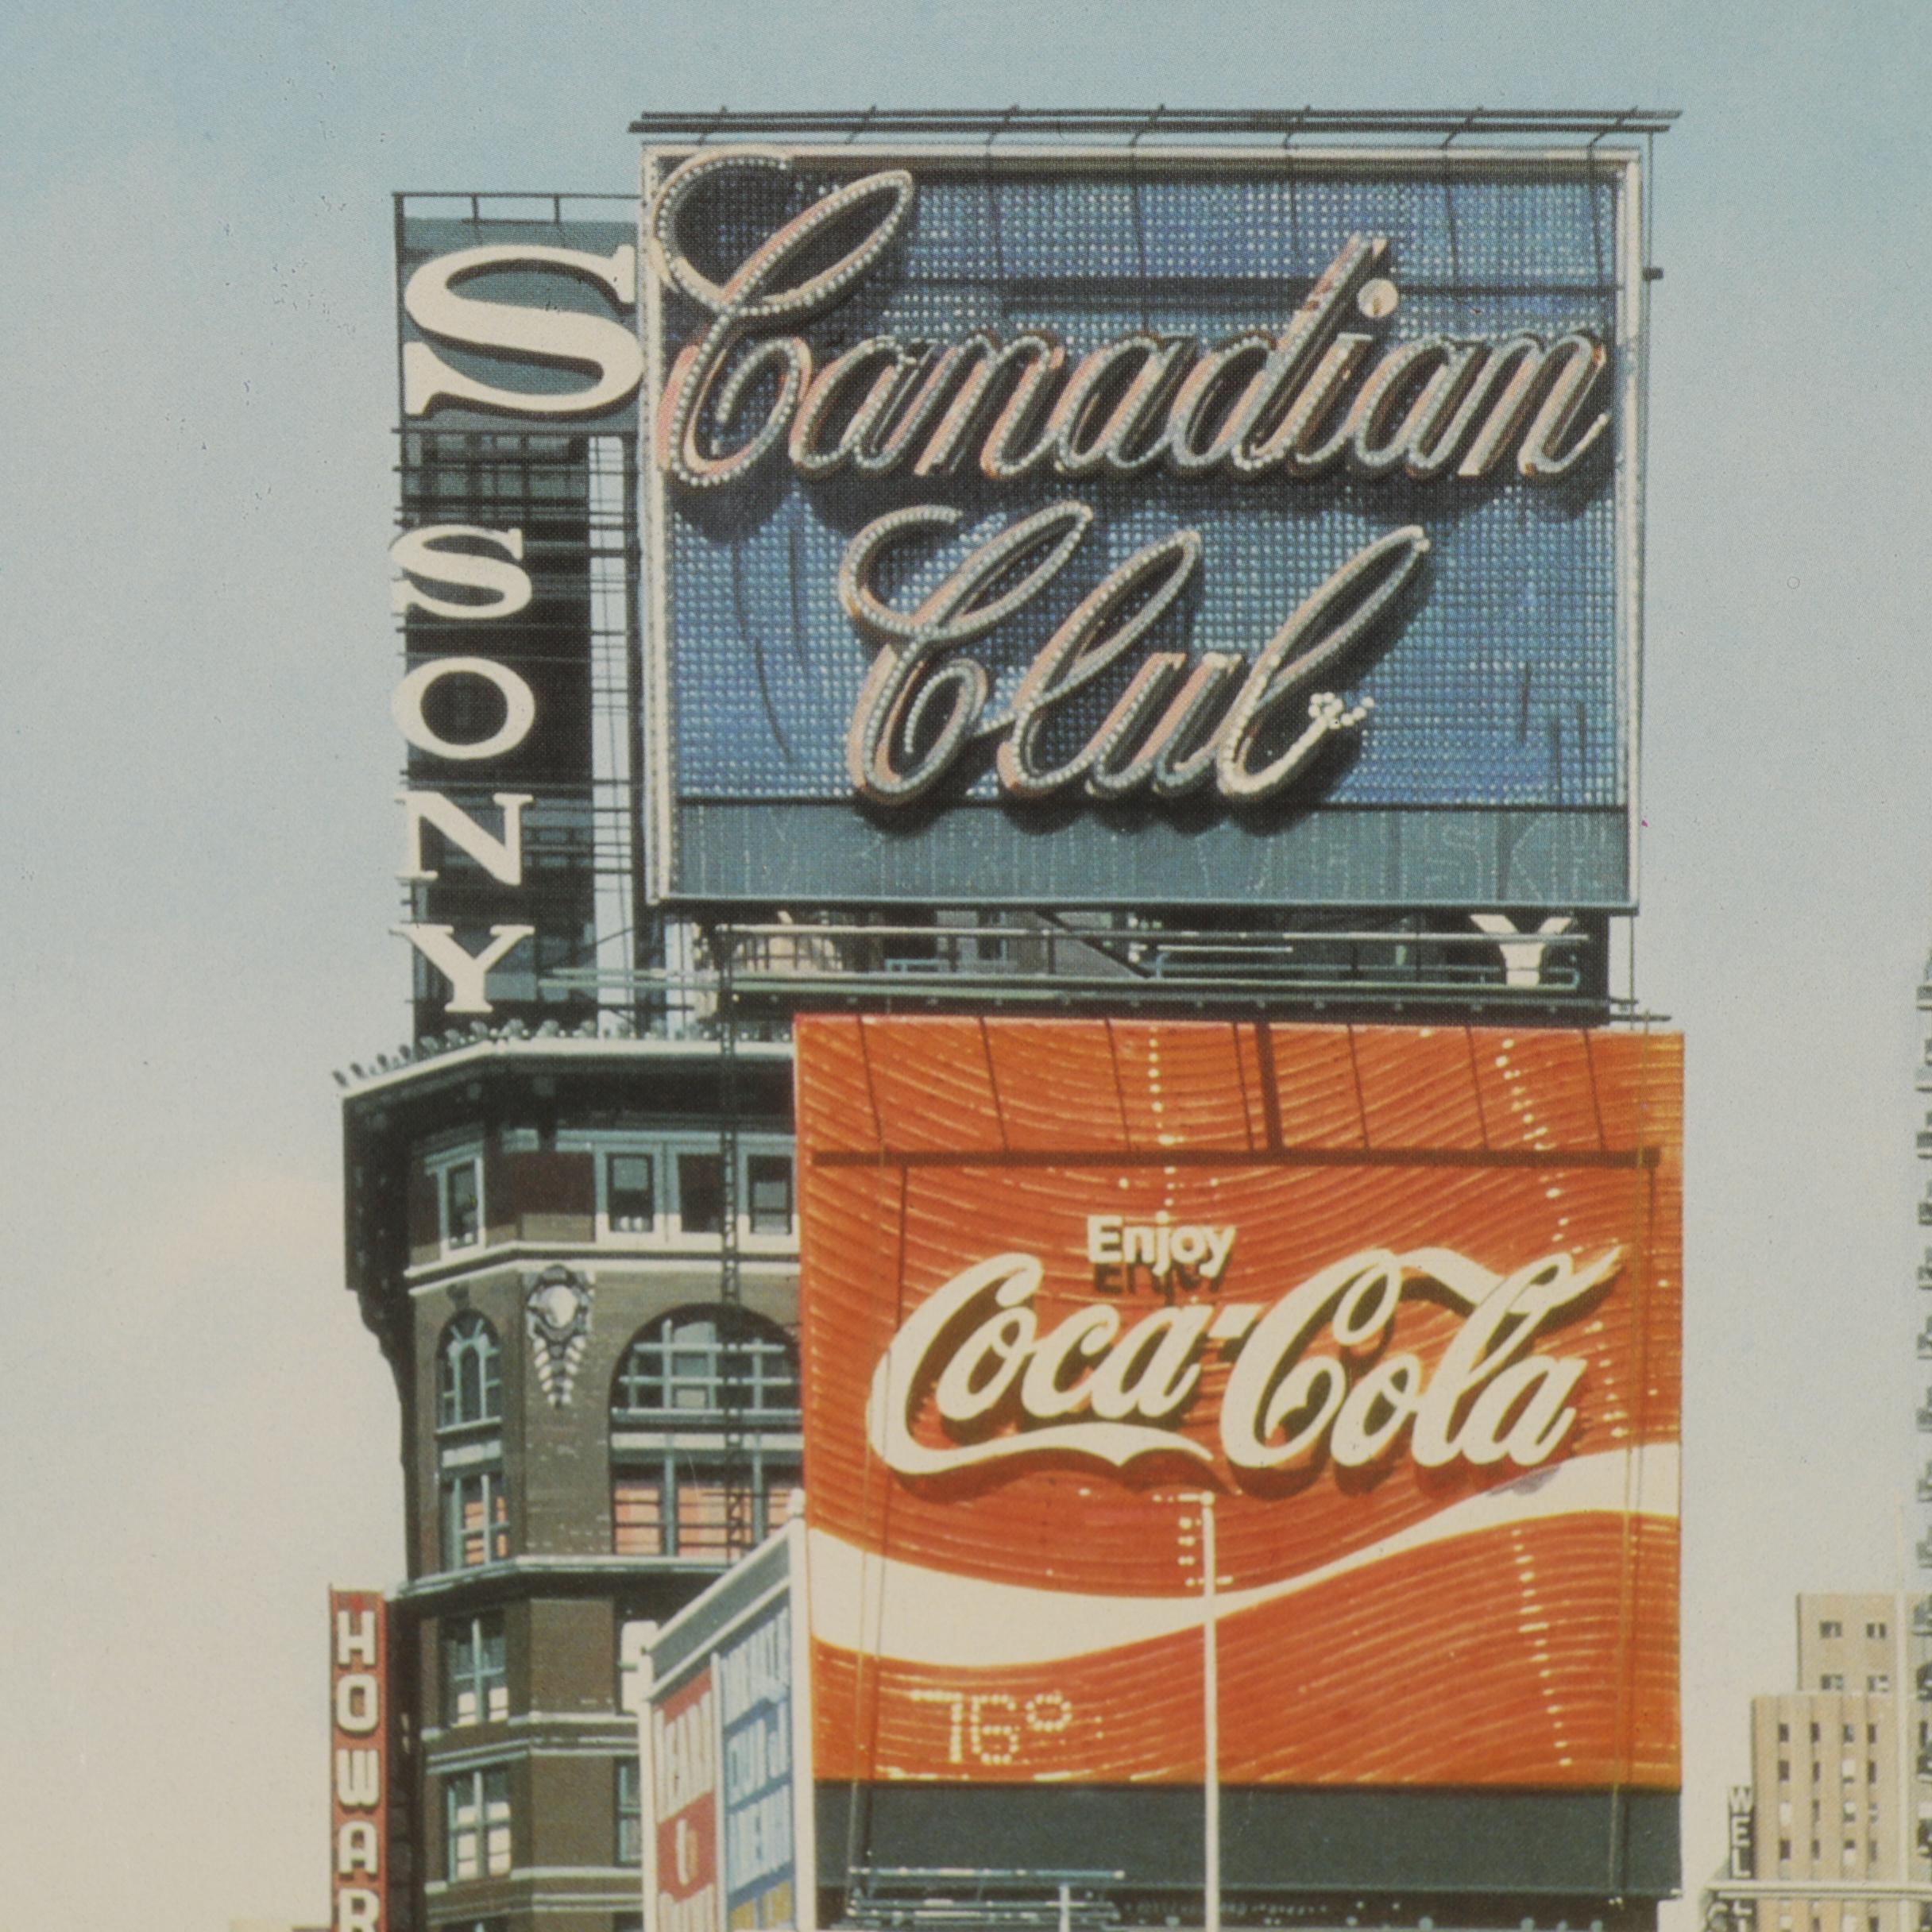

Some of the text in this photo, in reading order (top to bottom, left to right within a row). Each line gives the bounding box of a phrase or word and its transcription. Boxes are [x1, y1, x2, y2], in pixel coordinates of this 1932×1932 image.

[651, 149, 1610, 489] Canadian
[389, 524, 536, 1014] SONY
[839, 500, 1432, 803] Club
[866, 1245, 1625, 1475] Coca-Cola
[1085, 1213, 1236, 1279] Enjoy
[335, 1610, 381, 1932] HOWAR
